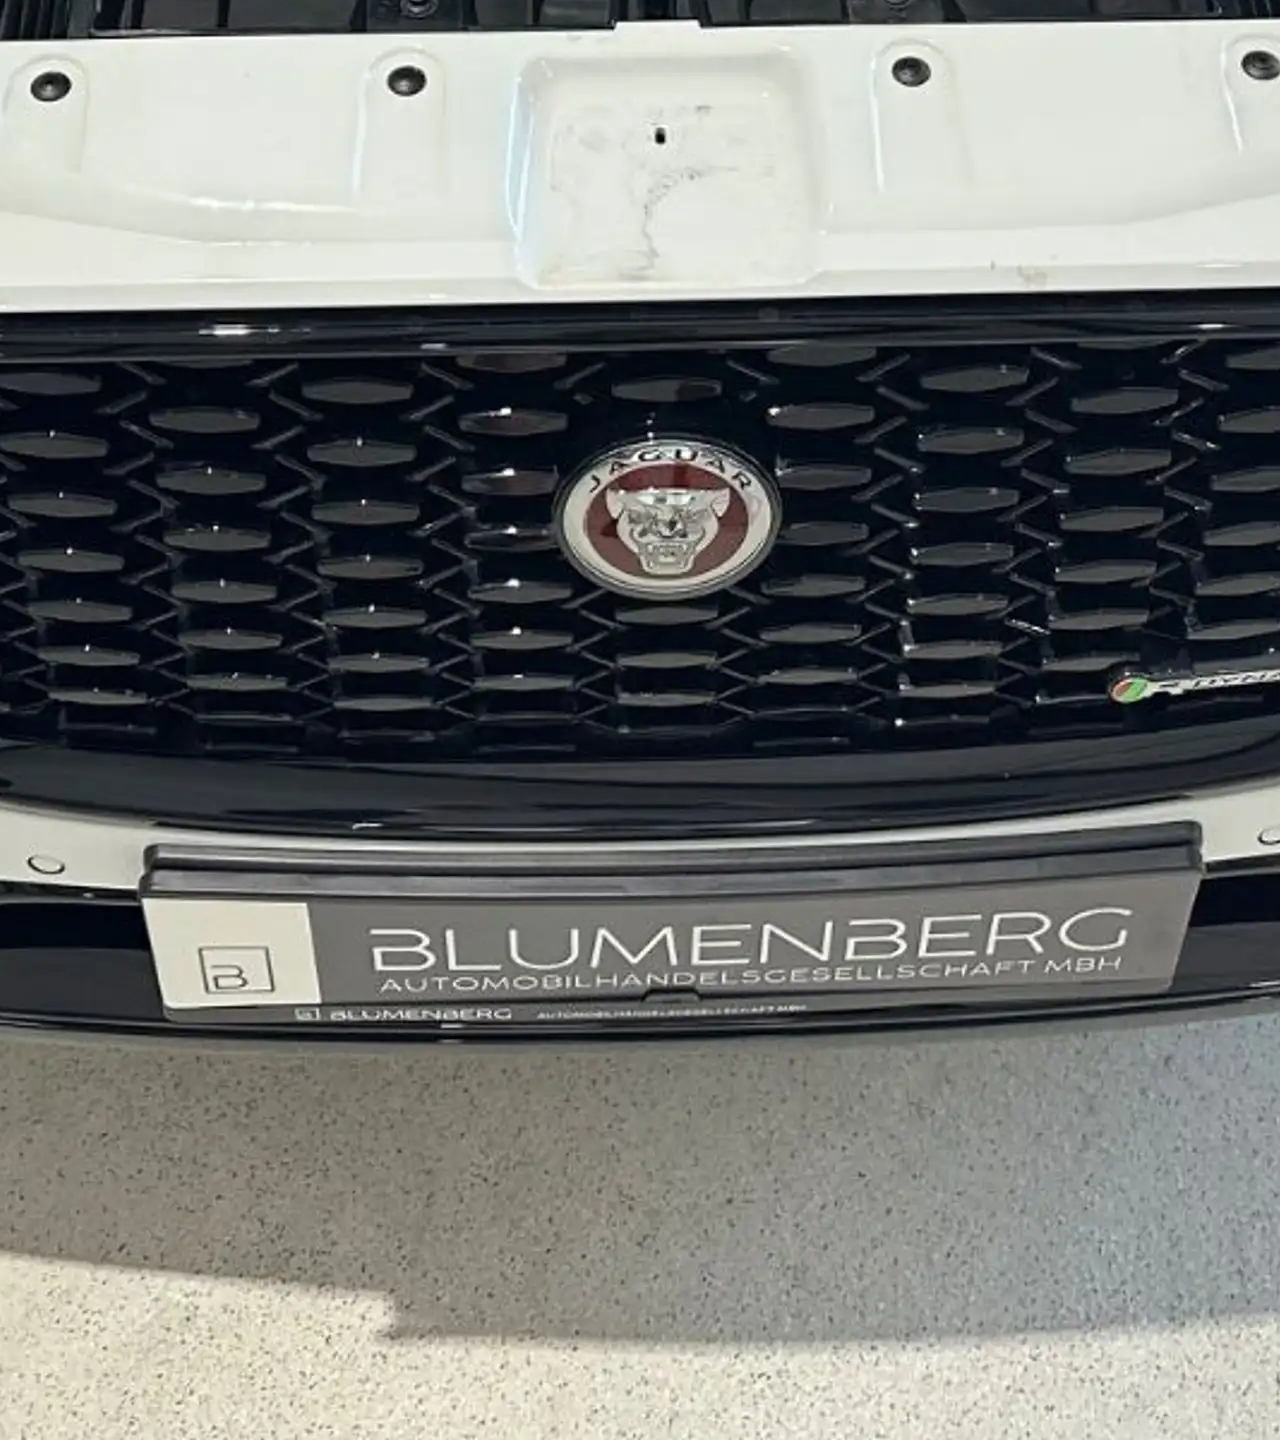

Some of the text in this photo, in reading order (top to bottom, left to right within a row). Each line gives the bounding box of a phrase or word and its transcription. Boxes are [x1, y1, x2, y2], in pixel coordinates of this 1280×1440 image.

[589, 448, 753, 493] JAGUAR
[369, 906, 1132, 971] BLUMENBERG
[210, 964, 248, 990] B
[380, 956, 1122, 993] AUTOMOBILHANDELSGESELLSCHAFT MBH
[329, 1006, 513, 1021] BLUMENBERG
